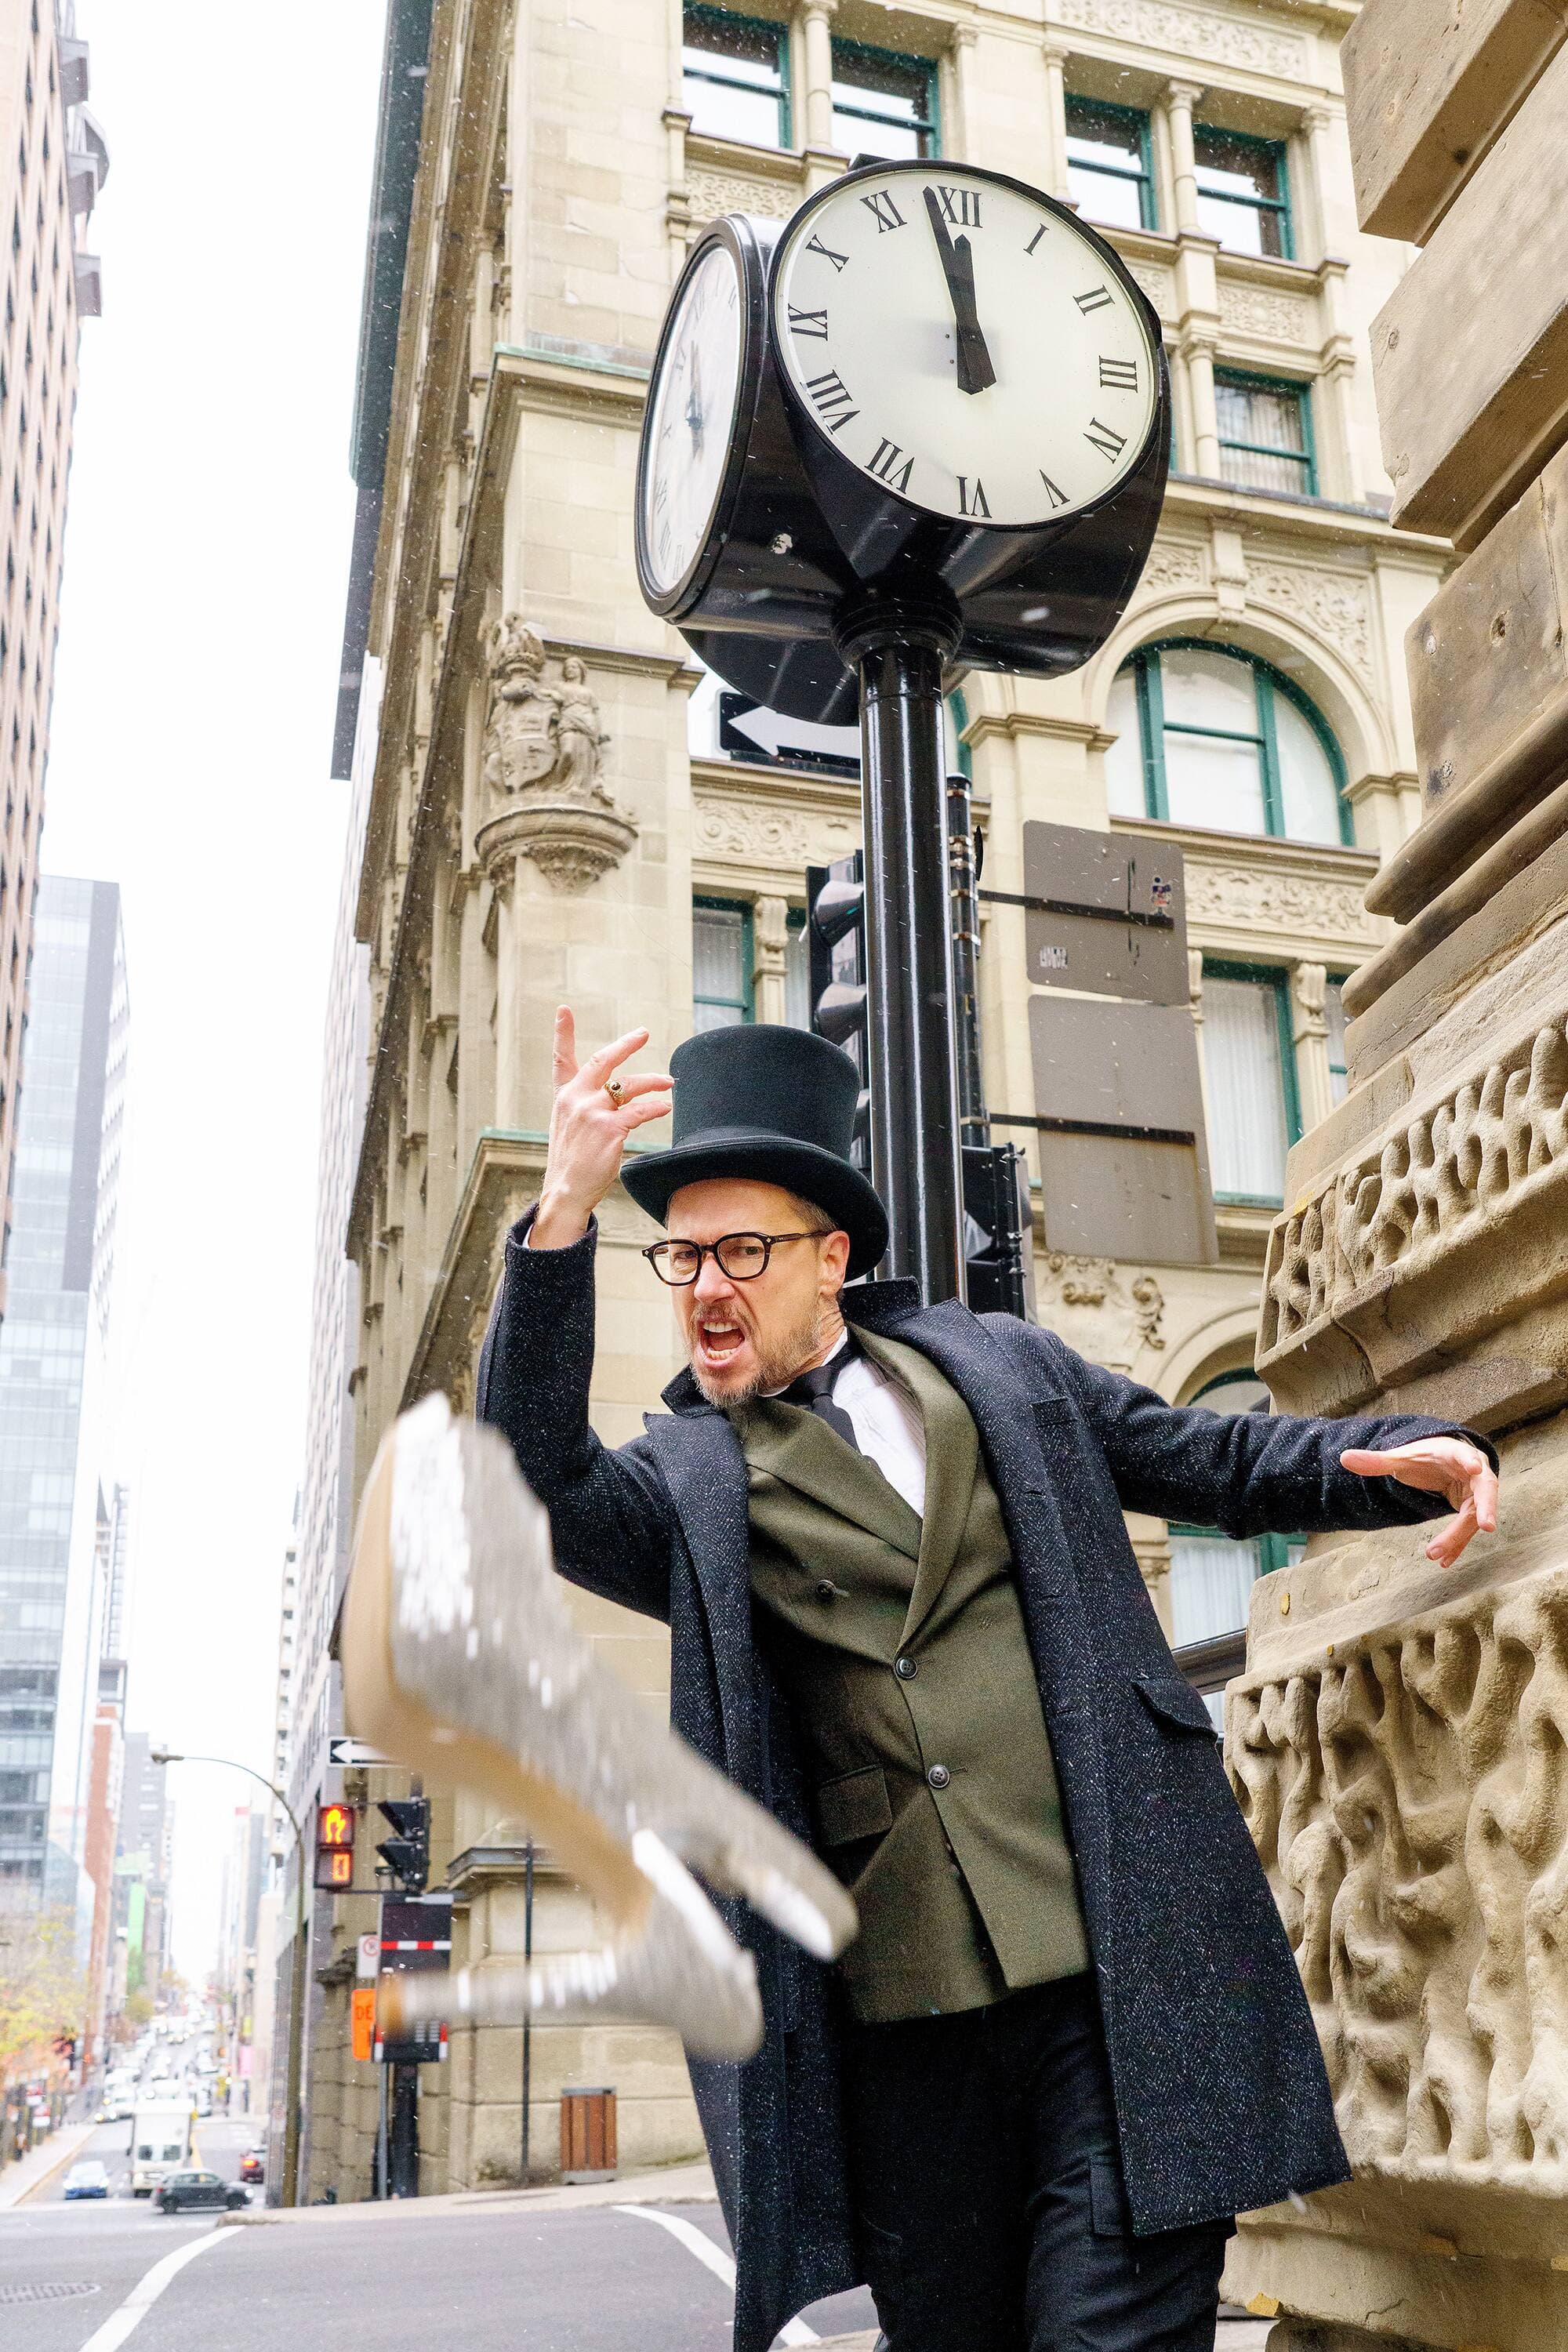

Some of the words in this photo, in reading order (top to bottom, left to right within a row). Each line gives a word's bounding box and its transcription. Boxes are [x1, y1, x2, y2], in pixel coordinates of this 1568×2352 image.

[860, 190, 907, 233] XI
[937, 186, 983, 228] XII
[806, 234, 849, 272] X
[1024, 223, 1049, 256] I
[1073, 285, 1115, 316] II
[788, 303, 828, 341] IX
[1099, 356, 1138, 393] III
[806, 369, 860, 434] VIII
[1083, 418, 1127, 463] IV
[864, 437, 914, 495] VII
[956, 476, 992, 518] VI
[1040, 470, 1070, 508] V
